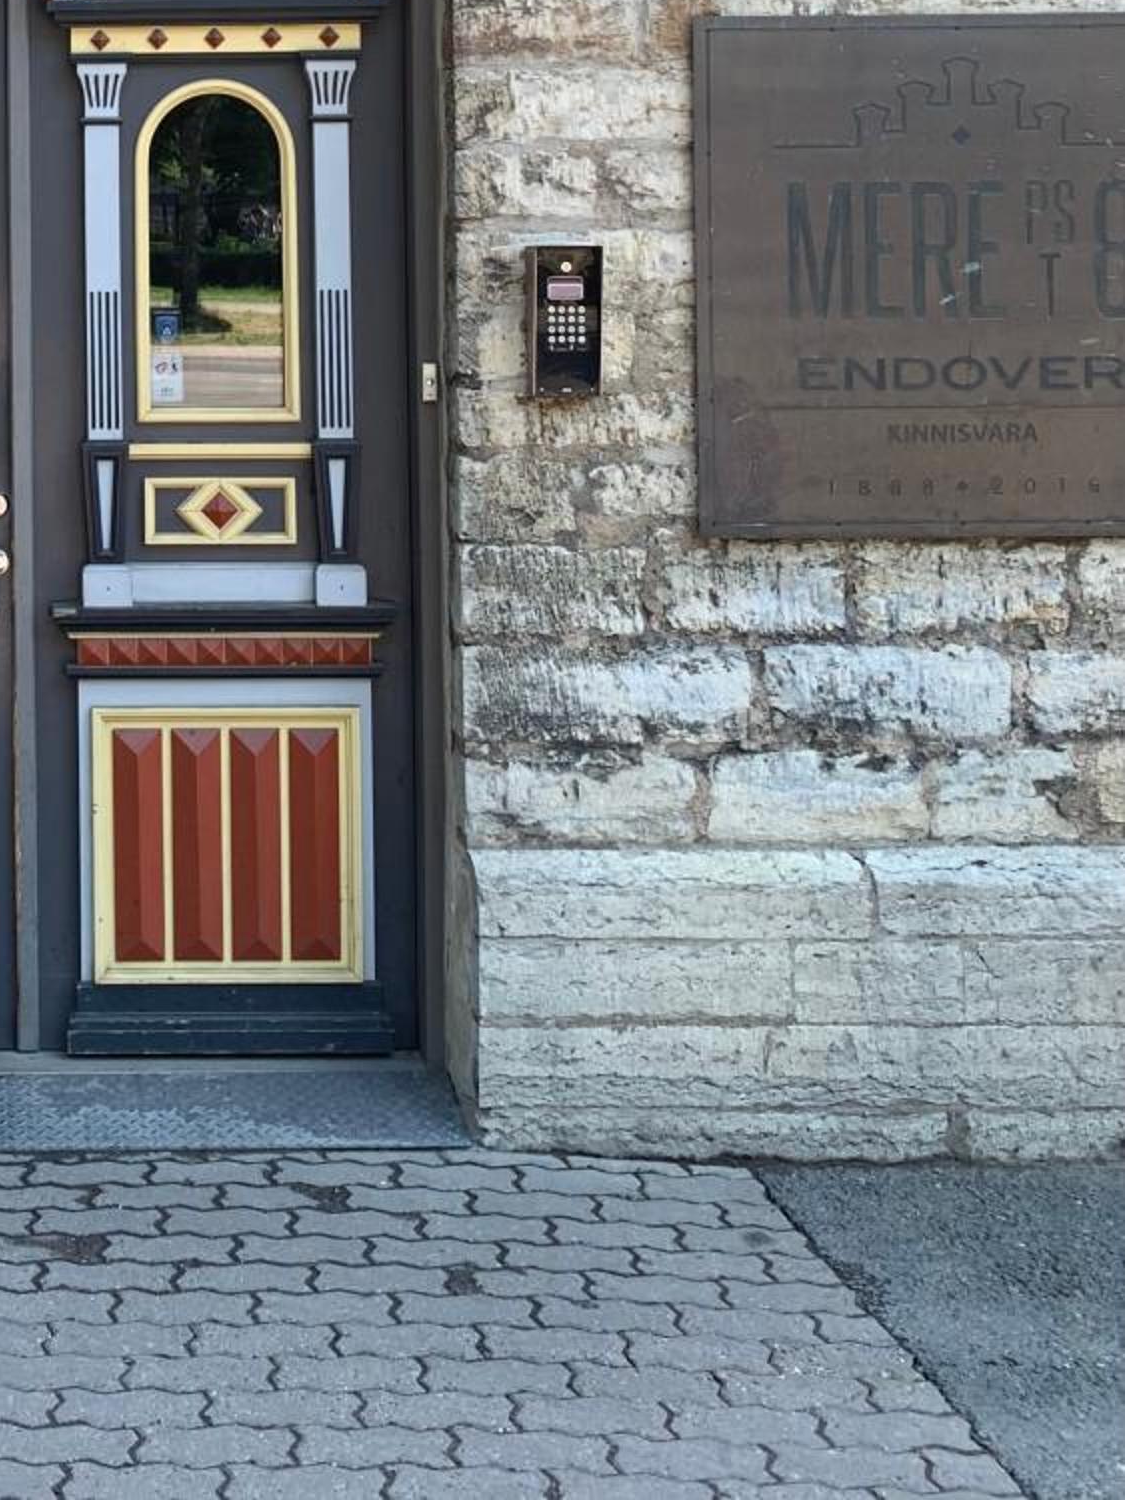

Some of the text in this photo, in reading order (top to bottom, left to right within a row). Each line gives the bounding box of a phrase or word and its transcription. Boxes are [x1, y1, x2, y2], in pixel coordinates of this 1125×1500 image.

[787, 181, 1004, 320] MERE
[797, 356, 1125, 391] ENDOVER
[887, 422, 1038, 445] KINNISVARA
